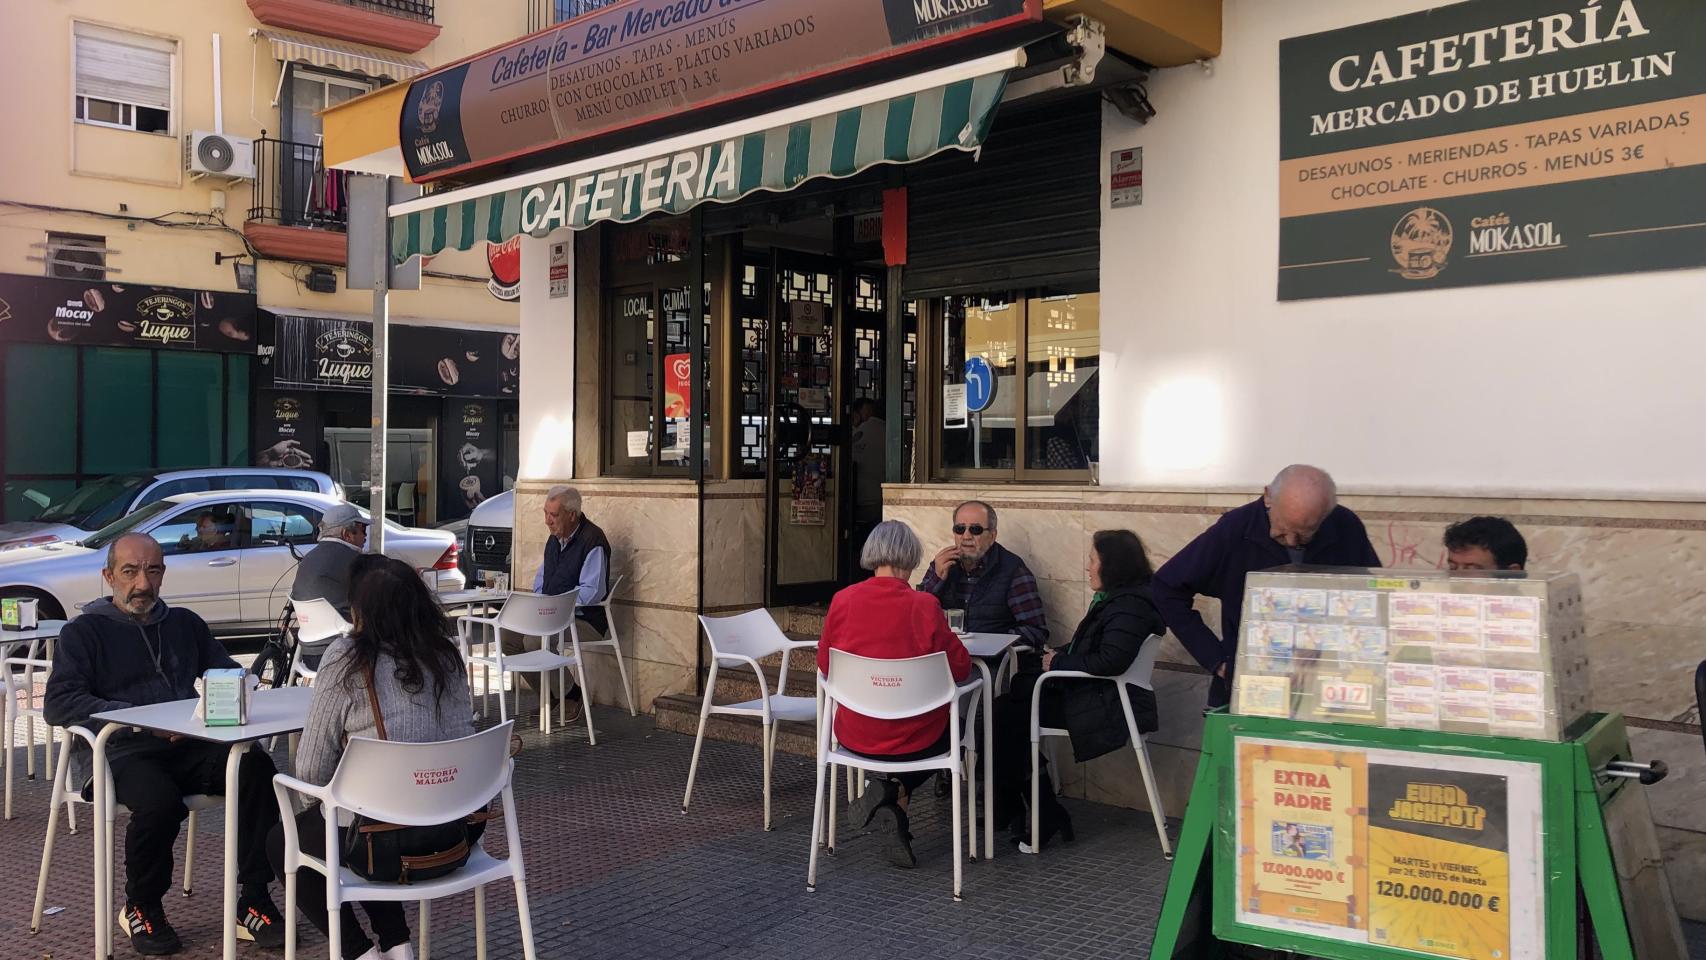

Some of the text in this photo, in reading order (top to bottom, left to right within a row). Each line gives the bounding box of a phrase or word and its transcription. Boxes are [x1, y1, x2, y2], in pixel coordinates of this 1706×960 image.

[492, 36, 568, 84] Cafetería
[583, 24, 617, 54] Bar
[620, 0, 712, 42] Mercado
[551, 56, 620, 90] DESAYUNOS
[632, 39, 672, 64] TAPAS
[685, 16, 736, 48] MENÚS
[1329, 0, 1650, 92] CAFETERÍA
[556, 87, 581, 108] CON
[585, 62, 664, 99] CHOCOLATE
[676, 41, 730, 73] PLATOS
[735, 15, 815, 54] VARIADOS
[575, 96, 612, 122] MENÚ
[693, 74, 702, 89] A
[706, 67, 721, 86] 3€
[1310, 50, 1676, 136] MERCADO DE HUELIN
[416, 141, 454, 166] MOKASOL
[1298, 156, 1393, 182] DESAYUNOS
[1408, 139, 1508, 166] MERIENDAS
[1525, 128, 1582, 149] TAPAS
[1589, 111, 1690, 140] VARIADAS
[1331, 175, 1427, 200] CHOCOLATE
[1443, 161, 1527, 186] CHURROS
[1545, 147, 1614, 172] MENÚS
[1622, 144, 1645, 161] 3€
[521, 140, 736, 233] CAFETERIA
[1471, 212, 1510, 228] Cafés
[1469, 222, 1561, 254] MOKASOL
[56, 306, 94, 322] Mocay
[144, 297, 187, 309] TEJERINGOS
[623, 297, 649, 317] LOCAL
[140, 319, 191, 344] Luque
[319, 357, 373, 385] Luque
[1325, 686, 1365, 701] 017
[413, 767, 458, 779] VICTORIA
[1274, 769, 1331, 789] EXTRA
[1274, 791, 1332, 812] PADRE
[1406, 782, 1466, 806] EURO
[1389, 799, 1485, 830] JACKPOT
[1262, 861, 1334, 881] 17.000.000
[1393, 855, 1430, 869] MARTES
[1432, 863, 1437, 871] y
[1388, 867, 1401, 876] por
[1418, 869, 1448, 882] BOTES
[1450, 874, 1460, 883] de
[1461, 875, 1487, 887] hasta
[1376, 880, 1500, 912] 120.000.000 €
